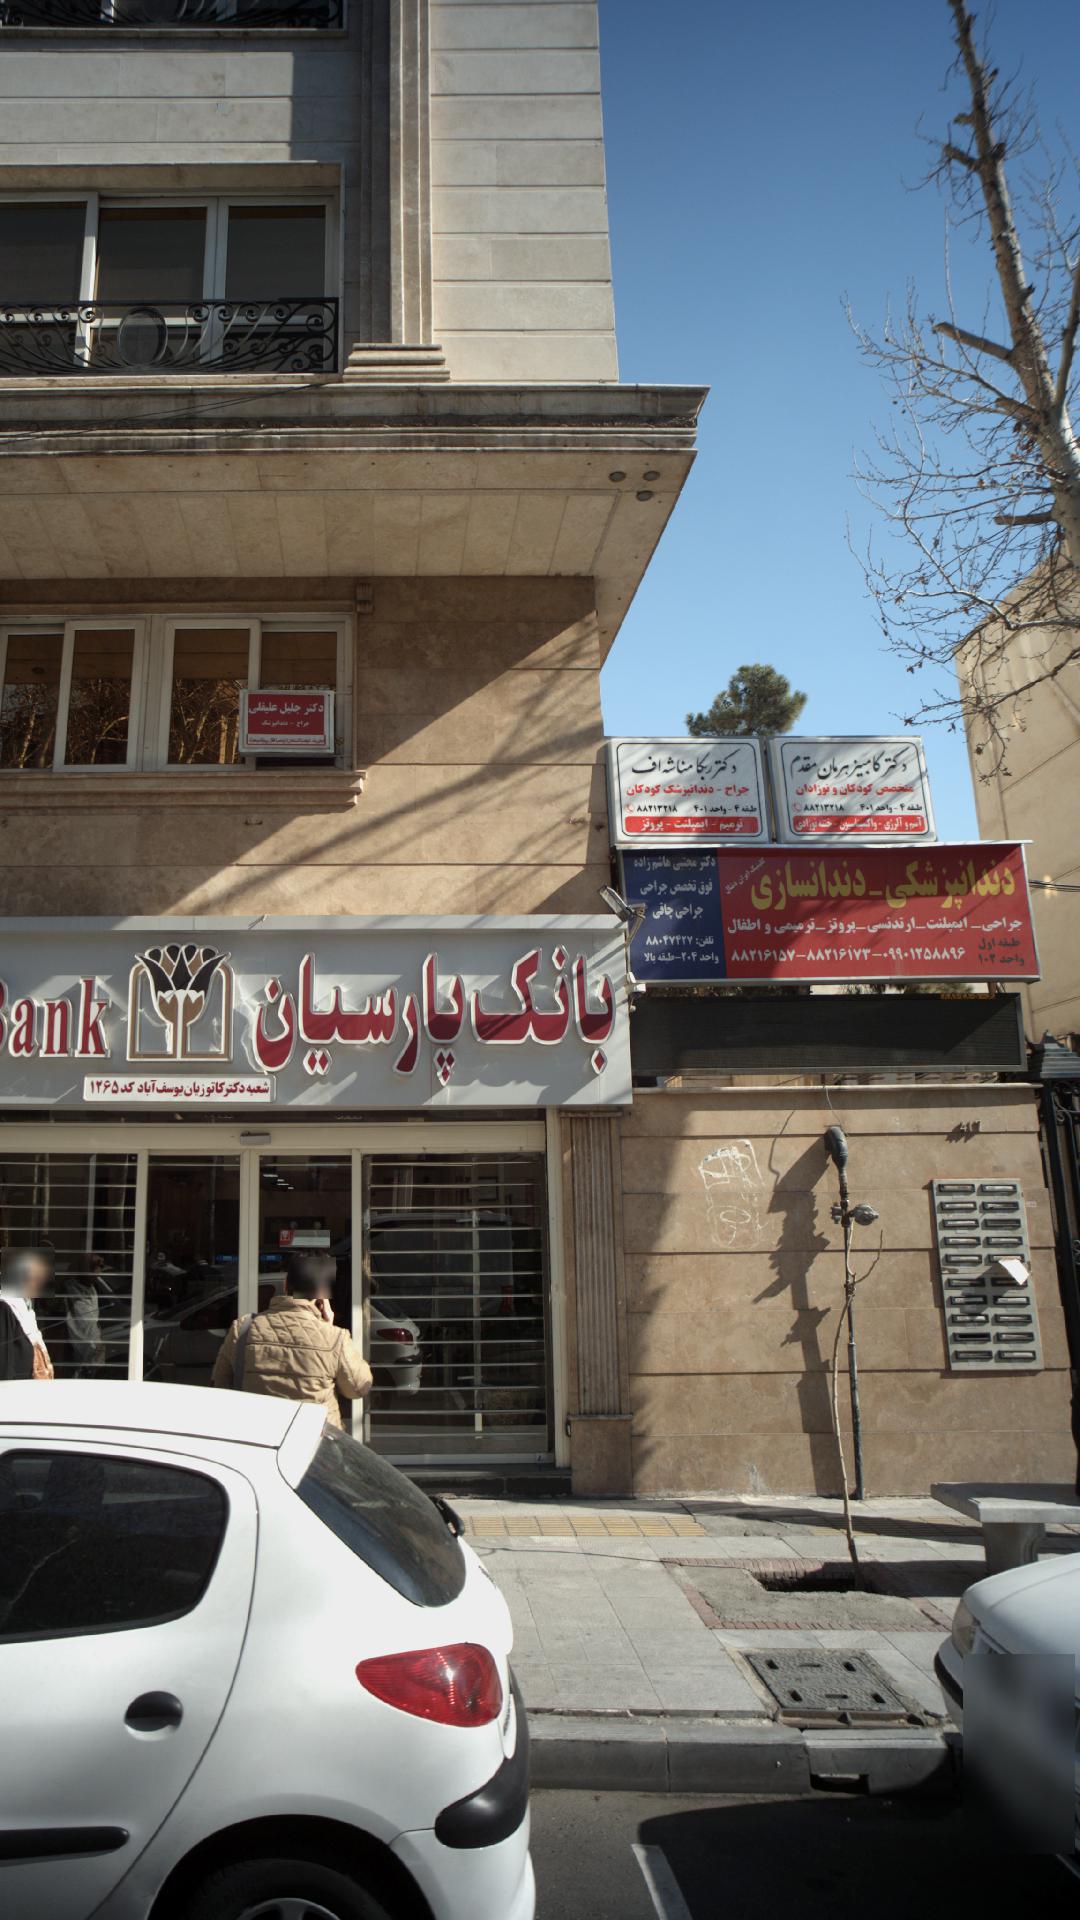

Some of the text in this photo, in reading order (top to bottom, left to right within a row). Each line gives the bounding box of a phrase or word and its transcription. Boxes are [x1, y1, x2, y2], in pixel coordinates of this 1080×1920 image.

[280, 702, 301, 715] جلیل
[303, 702, 324, 715] دکتر
[712, 749, 741, 779] دکتر
[790, 755, 817, 780] مقدم
[881, 746, 910, 778] دکتر
[626, 784, 660, 796] کودکان
[724, 784, 749, 796] جراح
[796, 783, 830, 796] نوزادان
[839, 783, 873, 795] کودکان
[876, 784, 914, 796] متخصص
[693, 804, 707, 812] ۴۰۱
[710, 804, 727, 814] واحد
[876, 803, 893, 813] واحد
[640, 818, 744, 831] ترمیم ایمپلنت پروتز
[700, 856, 716, 871] دکتر
[640, 879, 713, 895] فوق تخصص جراحی
[751, 859, 1015, 910] دندانپزشکی دندانسازی
[652, 902, 703, 919] جراحی چاقی
[727, 918, 761, 934] اطفال
[765, 924, 771, 934] و
[700, 952, 719, 964] واحد
[999, 954, 1025, 966] واحد
[0, 976, 110, 1057] ank
[252, 944, 617, 1087] بانک پارسیان
[120, 1081, 134, 1093] کد
[183, 1081, 226, 1097] کاتوزیان
[224, 1081, 249, 1097] دکتر
[247, 1081, 270, 1096] شعبه
